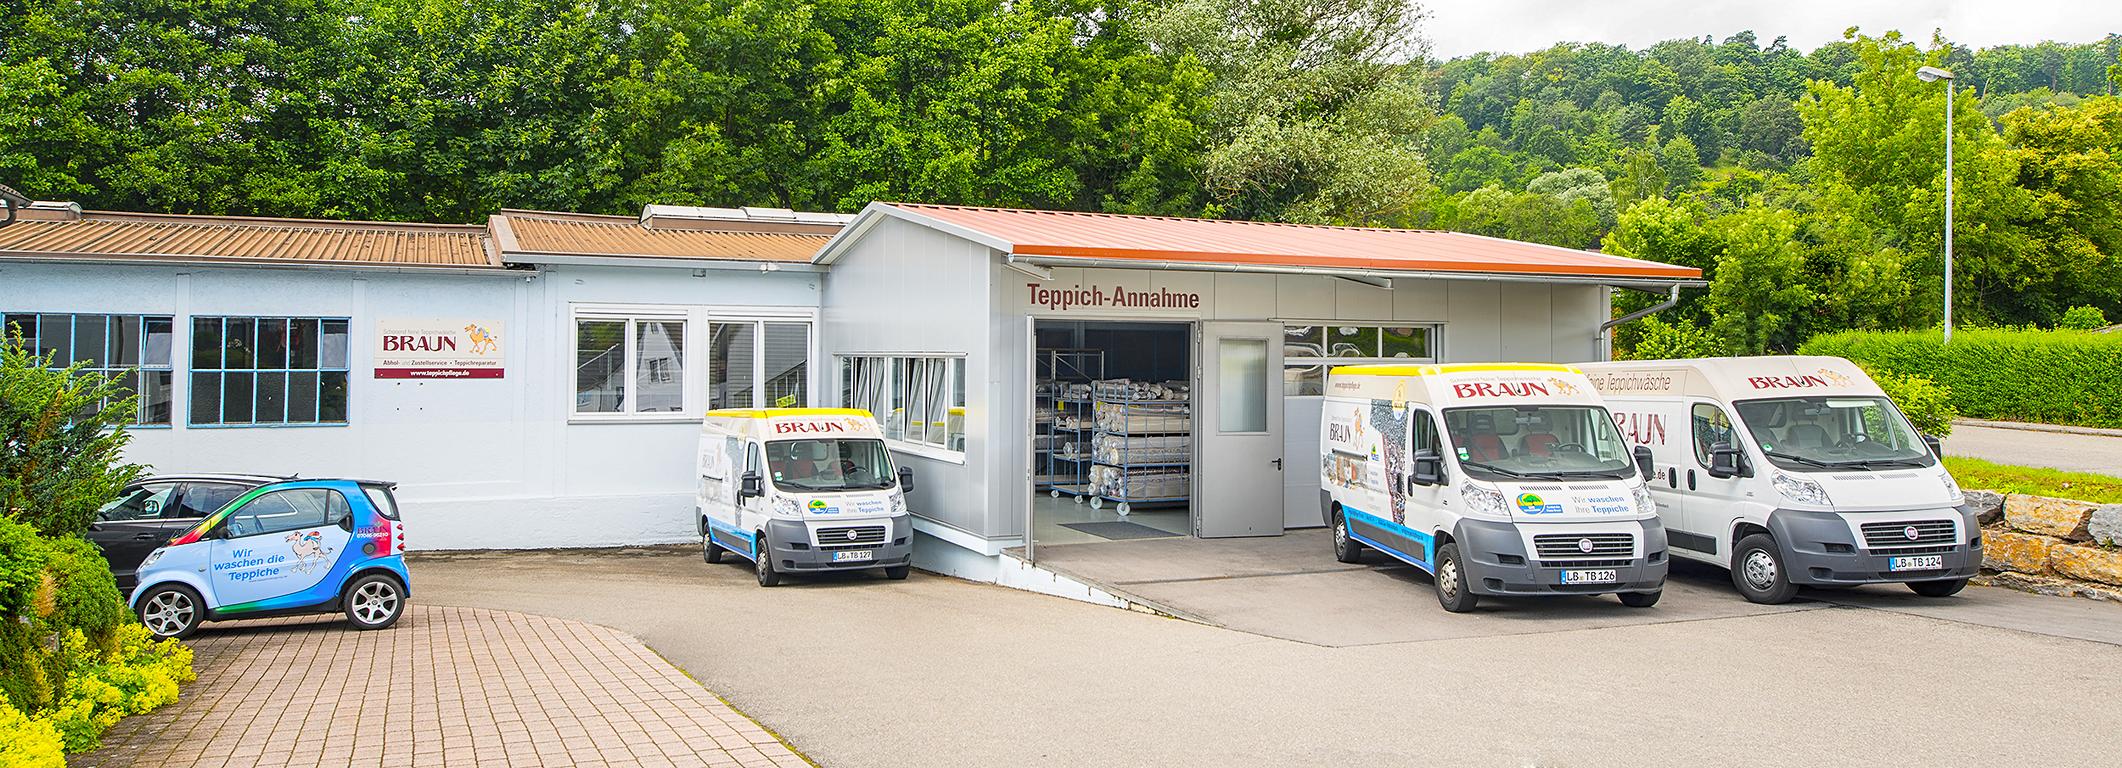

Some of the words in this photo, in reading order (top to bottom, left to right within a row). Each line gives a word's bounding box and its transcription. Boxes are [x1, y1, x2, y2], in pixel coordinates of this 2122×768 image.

[1027, 283, 1199, 310] Teppich-Annahme
[383, 335, 456, 352] BRAUN
[1607, 372, 1671, 394] Teppichwäsche
[1748, 375, 1828, 390] BRAUN
[1453, 382, 1550, 399] BRAUN
[775, 422, 844, 434] BRAUN
[1613, 412, 1666, 446] RAUN
[1588, 496, 1625, 504] waschen
[1592, 504, 1630, 514] Teppiche
[232, 548, 253, 559] Wir
[214, 557, 264, 571] waschen
[267, 554, 286, 565] die
[1895, 558, 1907, 568] LB
[1912, 557, 1924, 567] TB
[1926, 557, 1941, 566] 124
[228, 567, 280, 581] Teppiche
[1566, 571, 1579, 581] LB
[1586, 571, 1597, 580] TB
[1599, 570, 1615, 580] 126
